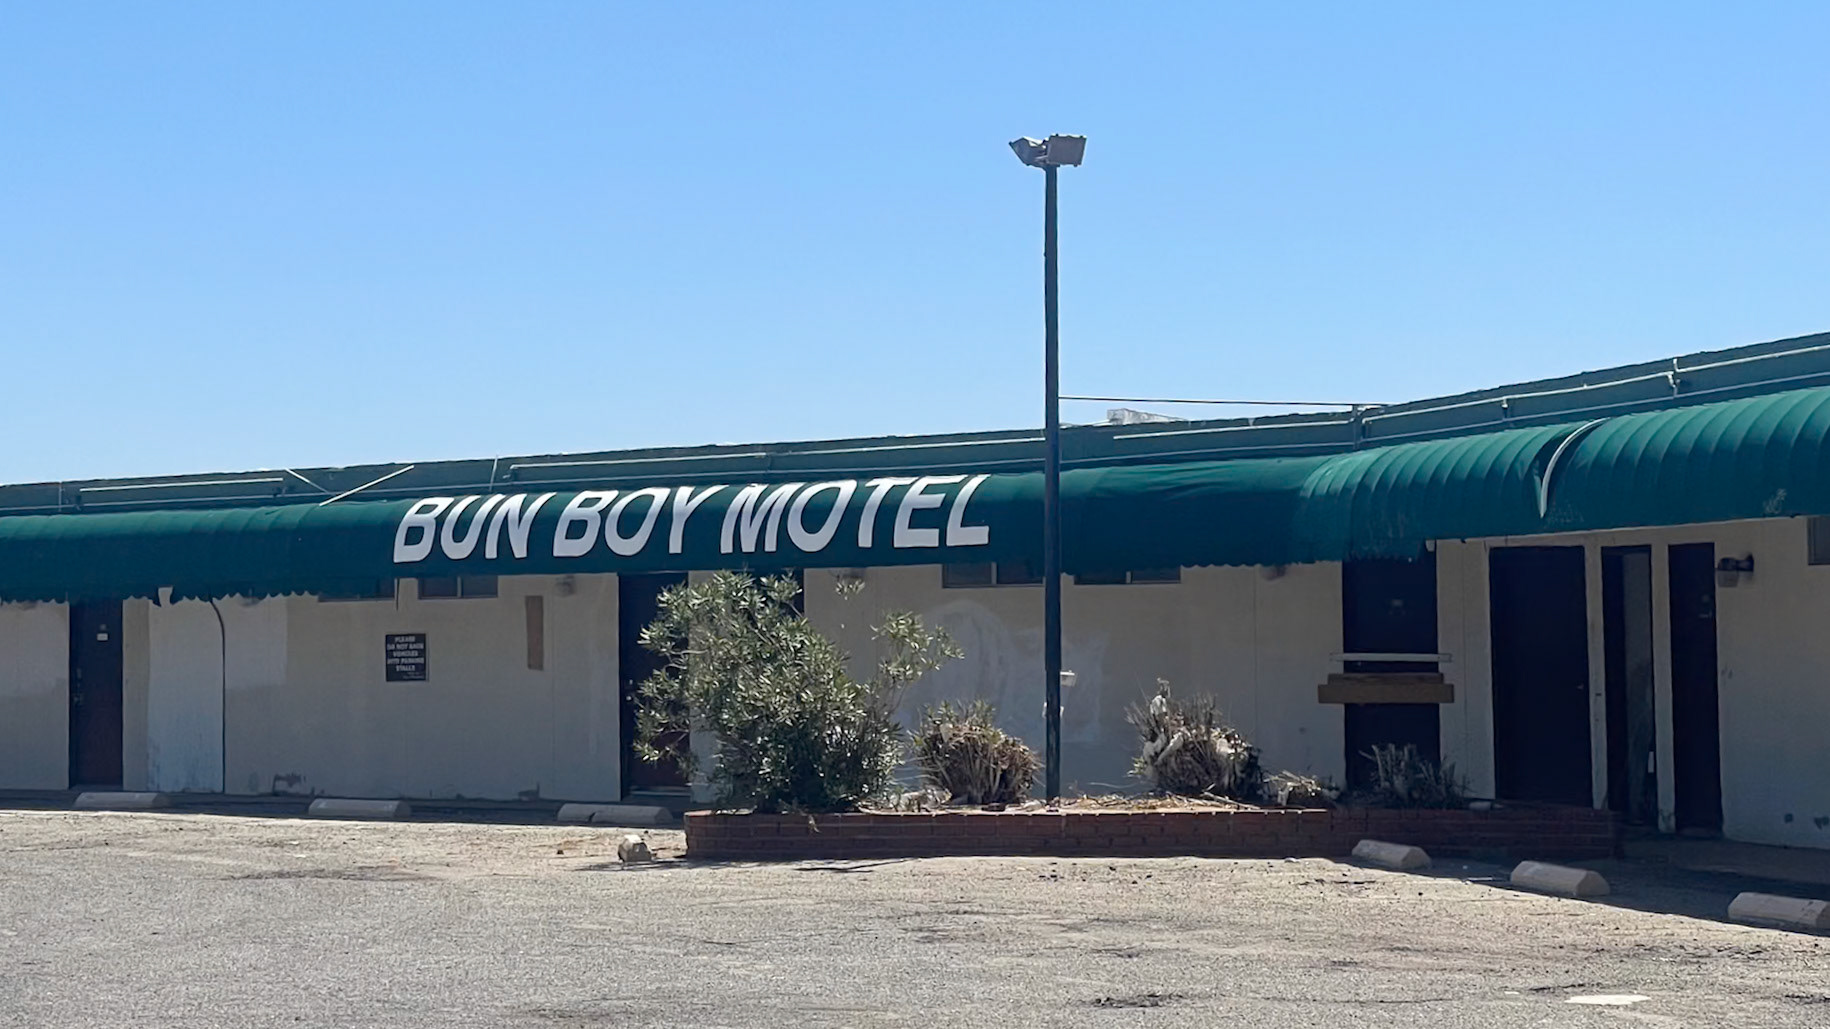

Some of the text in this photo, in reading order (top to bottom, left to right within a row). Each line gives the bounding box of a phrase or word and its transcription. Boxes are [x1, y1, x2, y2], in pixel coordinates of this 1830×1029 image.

[393, 474, 990, 563] BUN BOY MOTEL
